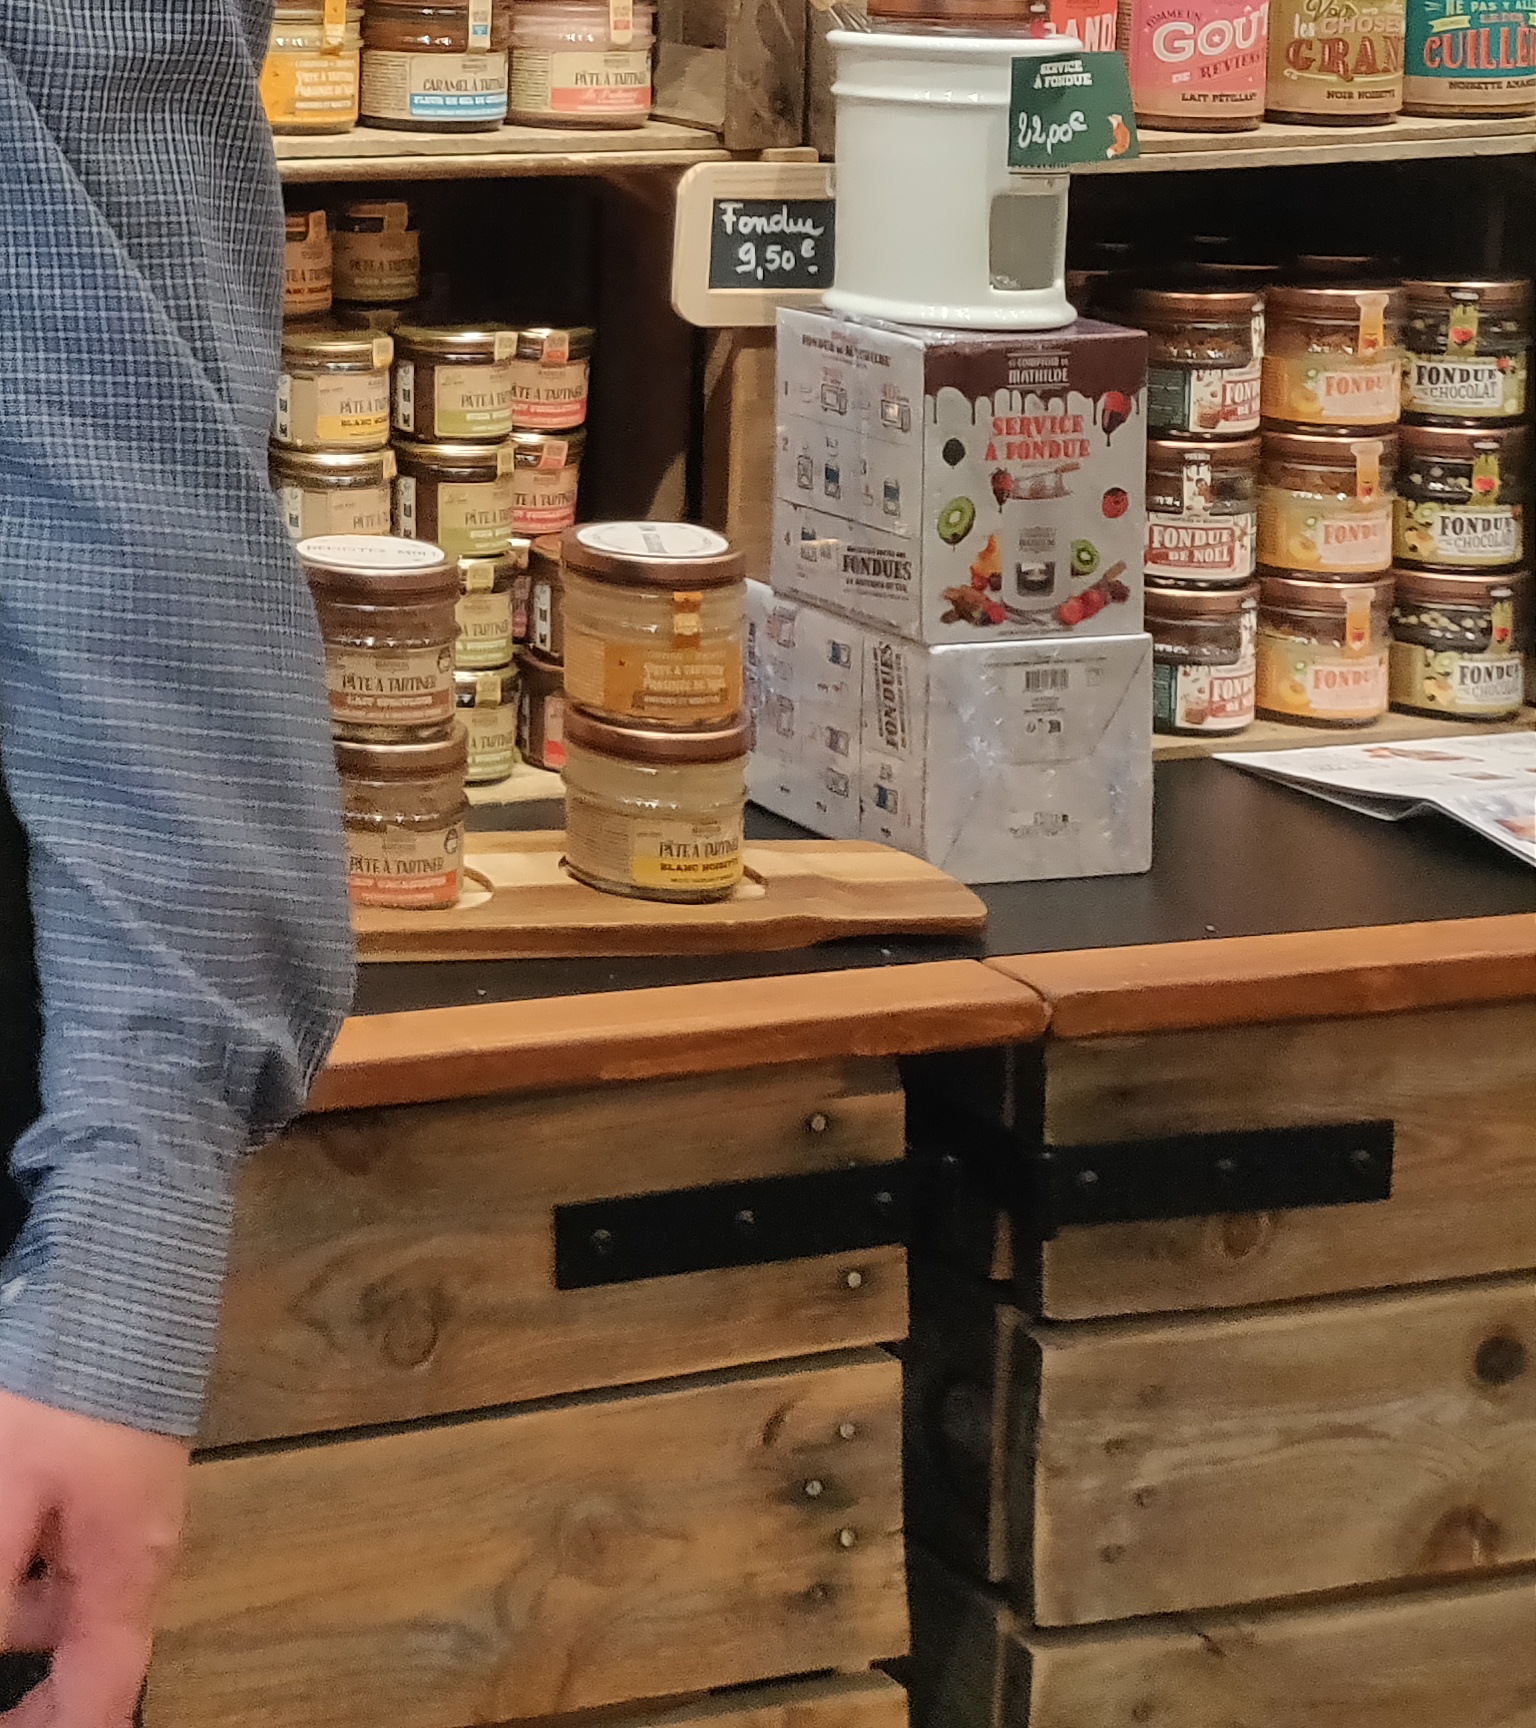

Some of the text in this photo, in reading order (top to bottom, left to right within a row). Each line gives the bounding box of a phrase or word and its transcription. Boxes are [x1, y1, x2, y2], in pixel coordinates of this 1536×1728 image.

[1471, 1, 1497, 12] PAS
[719, 201, 825, 237] Fondue
[1009, 368, 1069, 384] MATHILDE
[1414, 365, 1498, 385] FONDUE
[992, 415, 1084, 437] SERVICE
[1006, 440, 1091, 461] FONDUE
[1152, 527, 1232, 549] FONDUE
[843, 554, 913, 582] FONDUES
